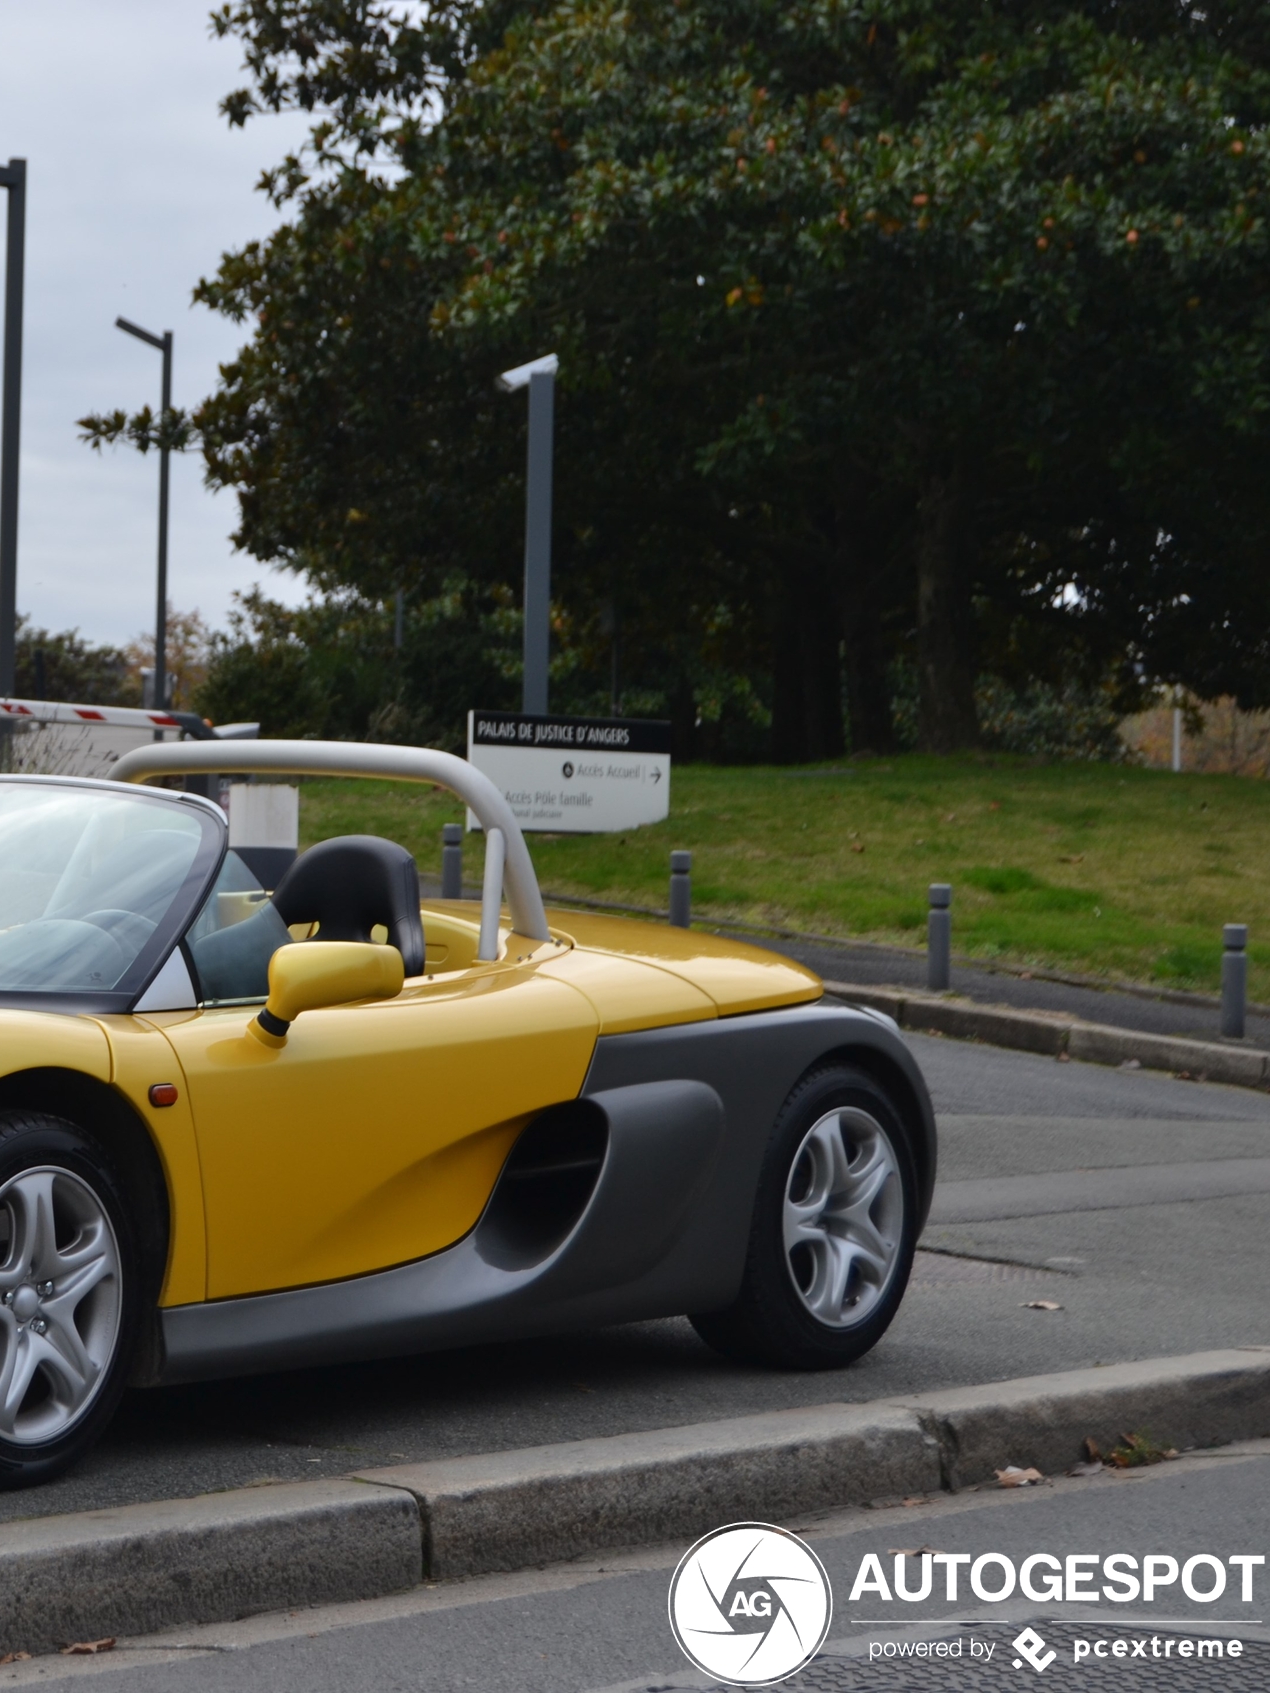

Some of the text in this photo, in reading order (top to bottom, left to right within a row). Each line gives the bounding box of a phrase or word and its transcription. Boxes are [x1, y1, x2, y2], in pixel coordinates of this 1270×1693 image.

[477, 720, 630, 746] PALAIS DE JUSTICE D'ANGERS
[577, 763, 641, 780] Accès Accueil
[505, 790, 594, 807] Accès Pôle famille
